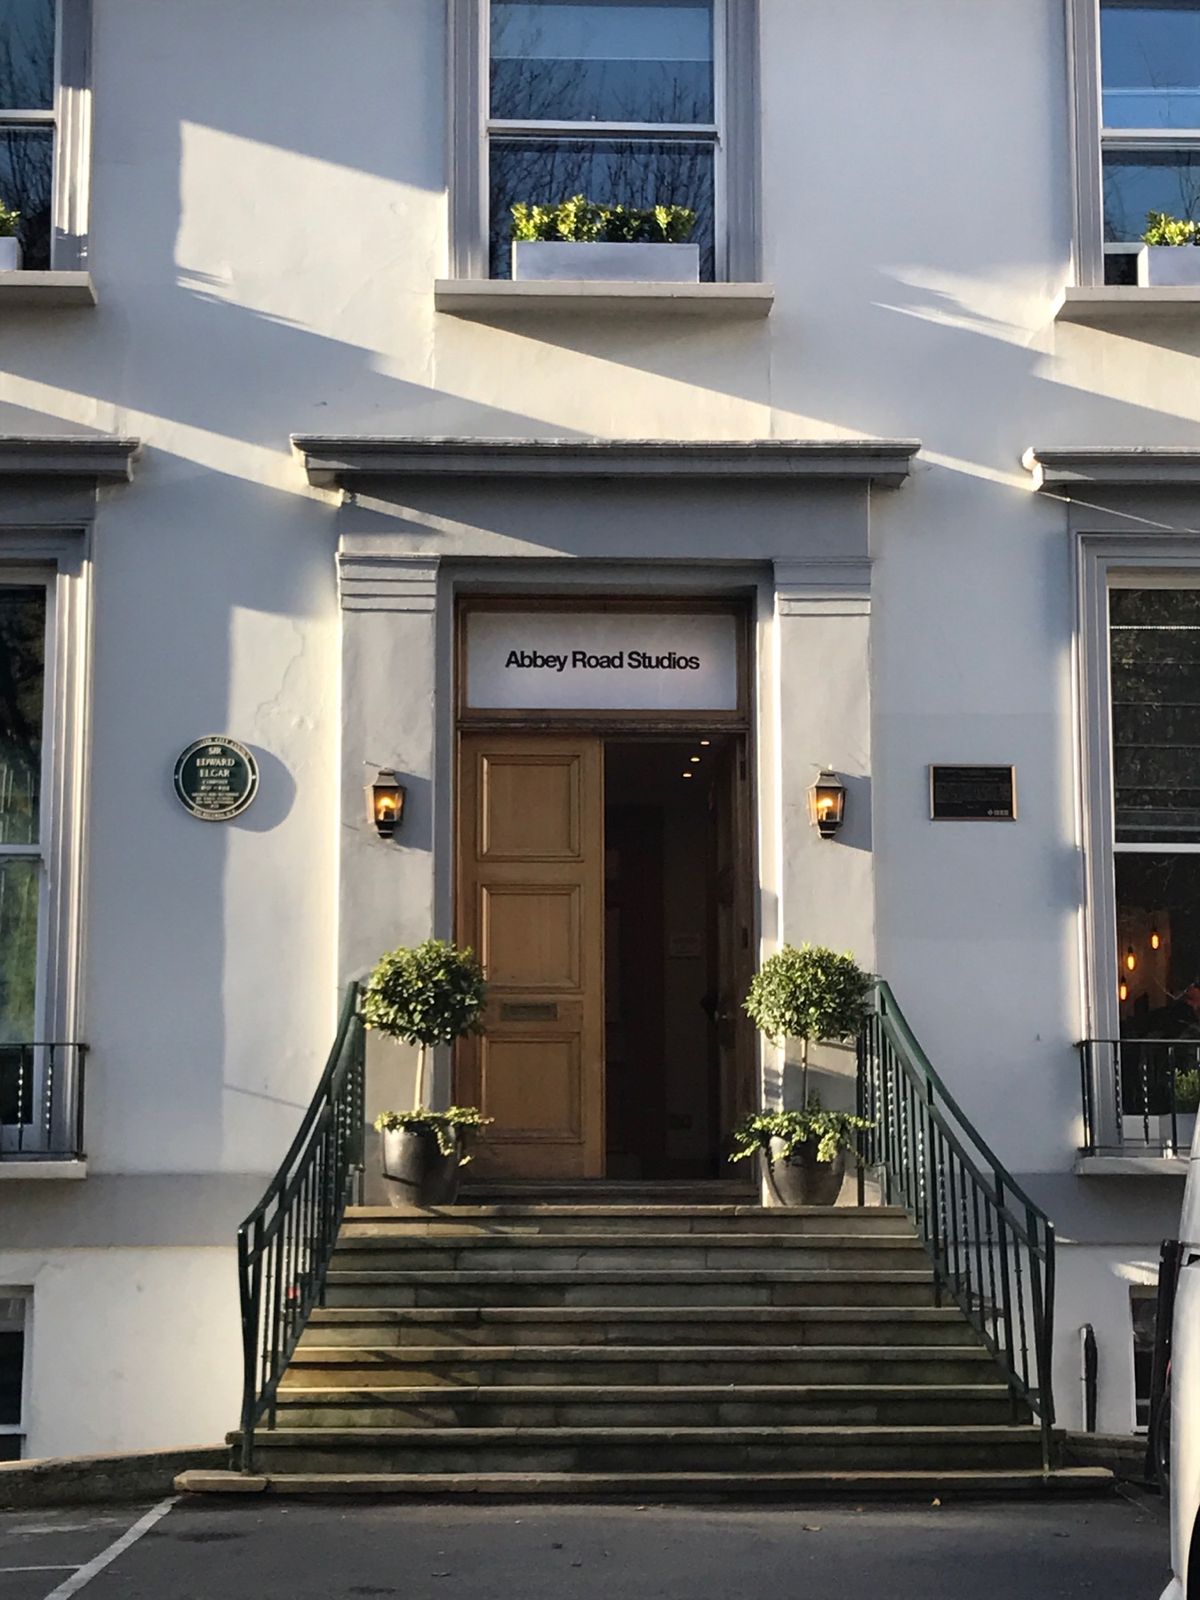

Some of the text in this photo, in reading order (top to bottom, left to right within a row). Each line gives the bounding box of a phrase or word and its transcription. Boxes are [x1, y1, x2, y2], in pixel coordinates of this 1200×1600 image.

[505, 650, 700, 672] Abbey Road Studios
[196, 758, 236, 767] EDWARD
